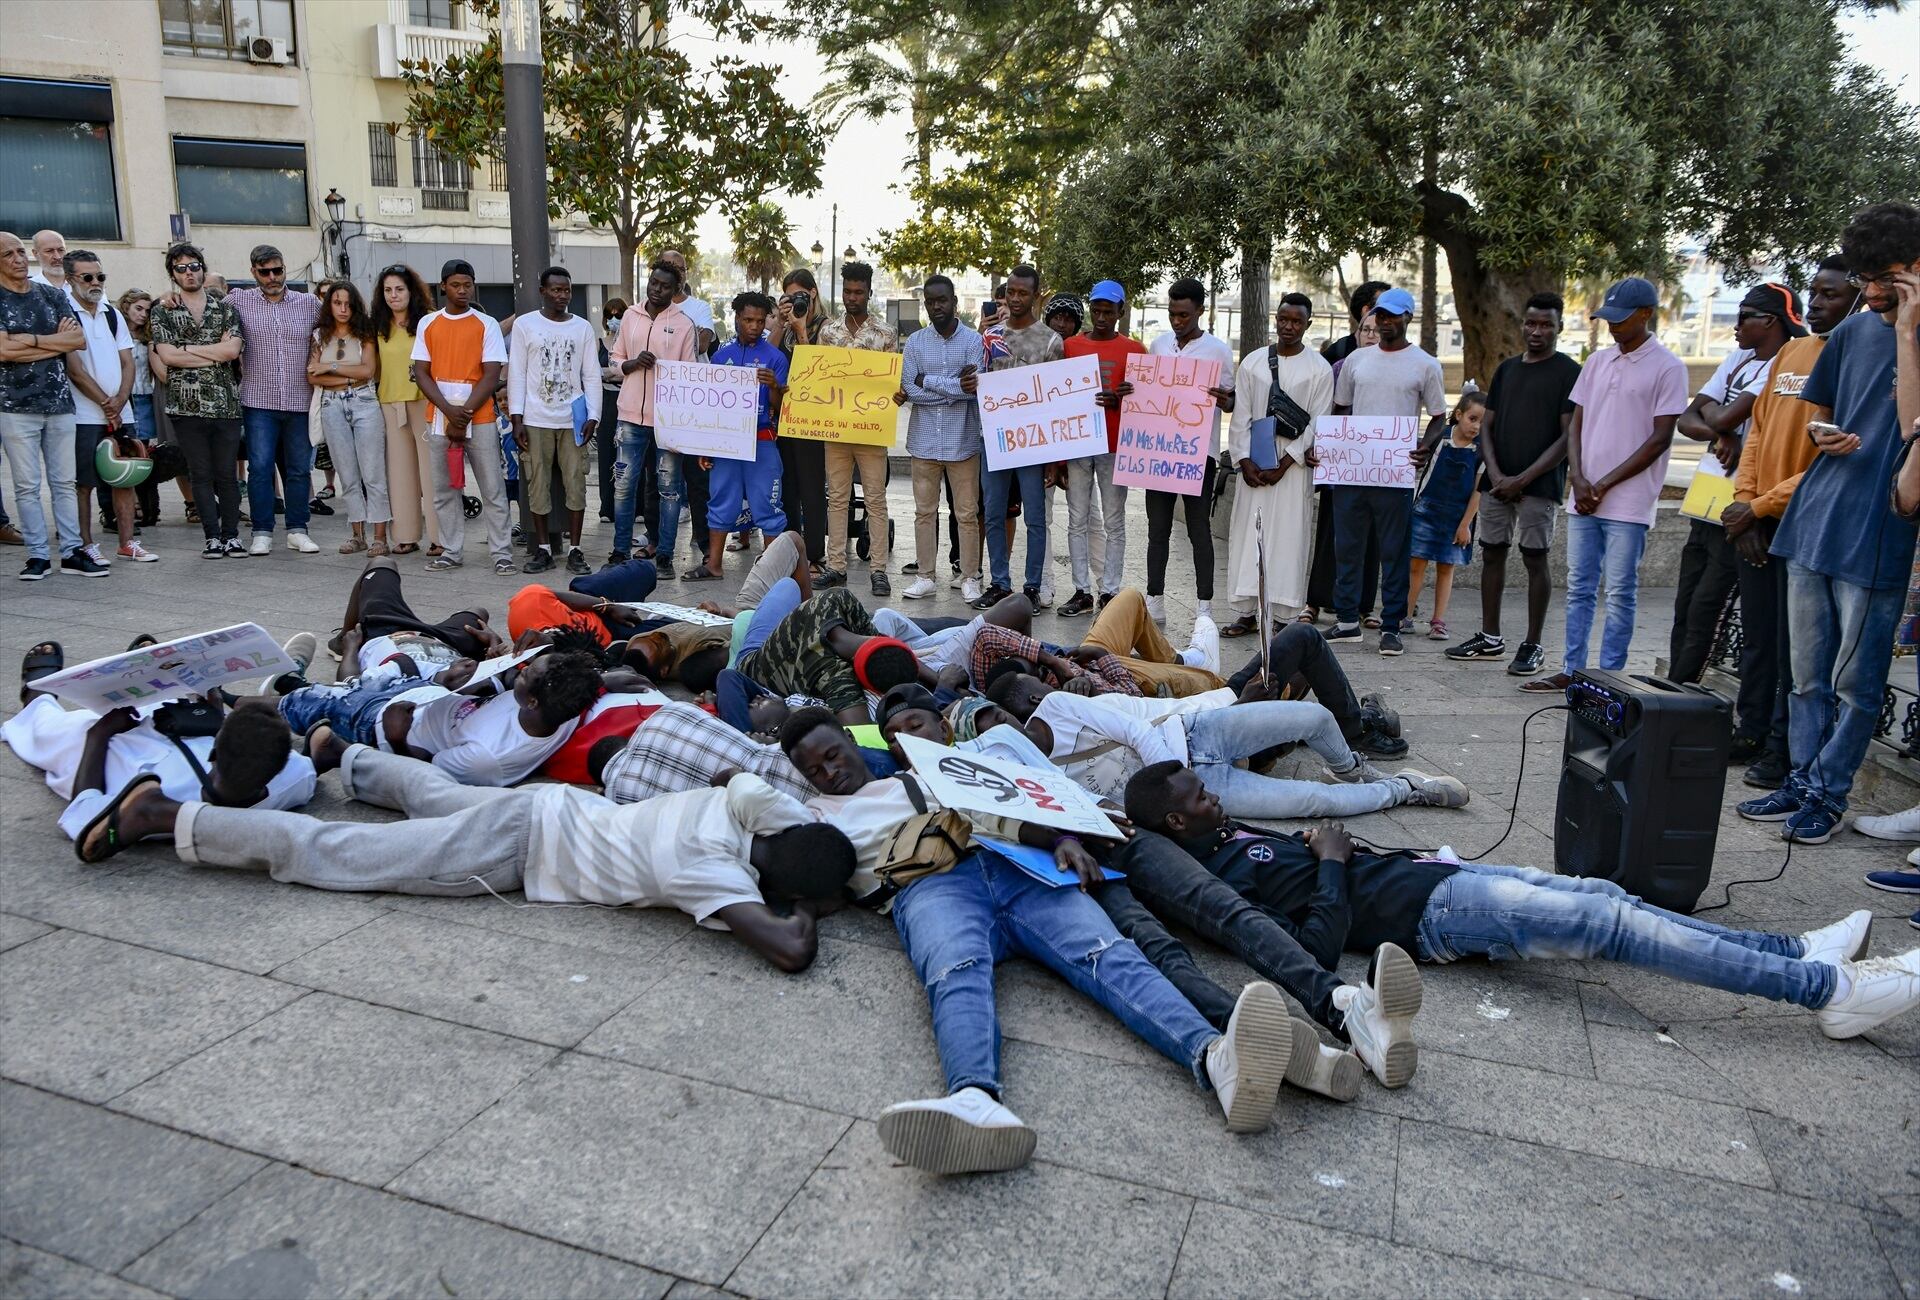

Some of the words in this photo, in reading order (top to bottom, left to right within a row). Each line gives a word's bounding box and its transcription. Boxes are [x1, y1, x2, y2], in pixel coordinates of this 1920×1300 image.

[787, 427, 796, 435] ES
[824, 420, 834, 428] ES
[1120, 428, 1134, 447] NO
[1315, 445, 1365, 466] PARAD
[1371, 447, 1413, 468] LAS
[1149, 458, 1203, 481] FRONTERAS
[1314, 463, 1415, 484] DEVOLUCIONES
[1014, 777, 1067, 813] NO
